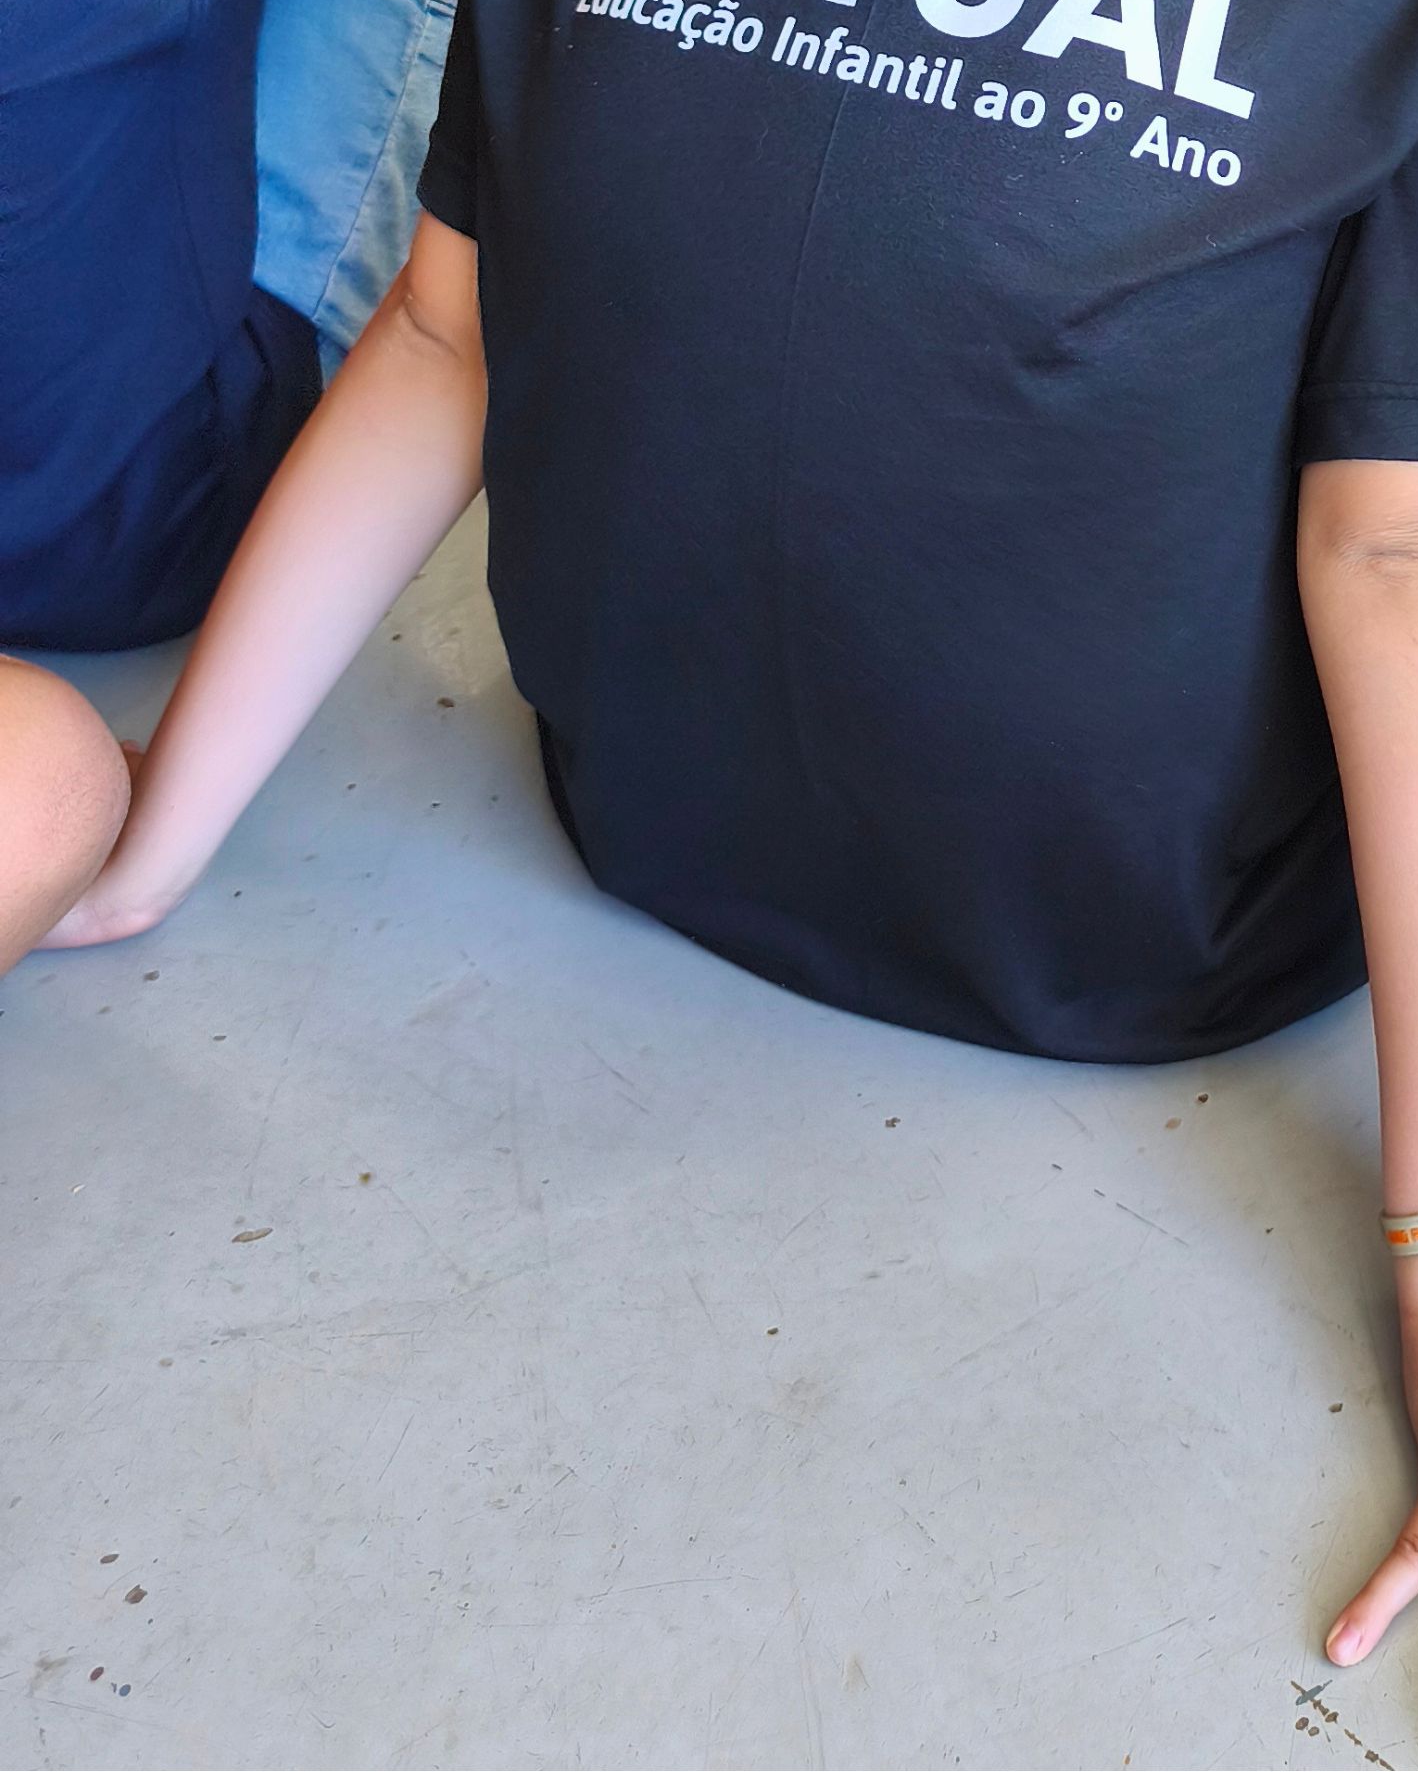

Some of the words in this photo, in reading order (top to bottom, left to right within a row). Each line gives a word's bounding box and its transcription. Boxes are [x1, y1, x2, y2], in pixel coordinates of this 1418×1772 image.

[772, 17, 963, 109] Infantil
[974, 82, 1045, 128] ao
[1130, 116, 1241, 187] Ano
